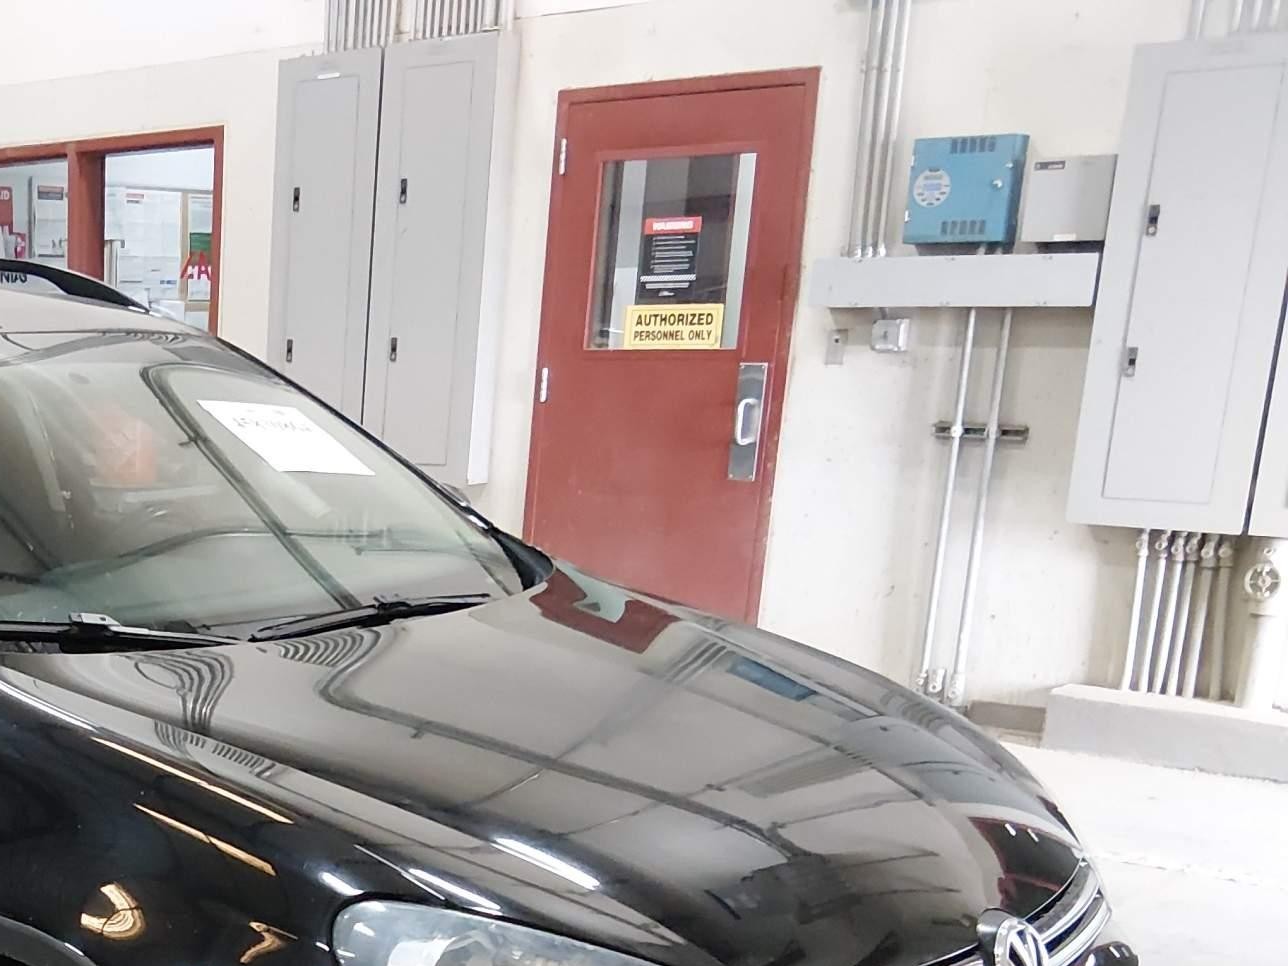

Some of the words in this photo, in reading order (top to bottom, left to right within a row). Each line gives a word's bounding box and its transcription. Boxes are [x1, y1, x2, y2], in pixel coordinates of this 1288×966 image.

[635, 313, 714, 326] AUTHORIZED
[633, 330, 685, 341] PERSONNEL
[688, 329, 712, 340] ONLY
